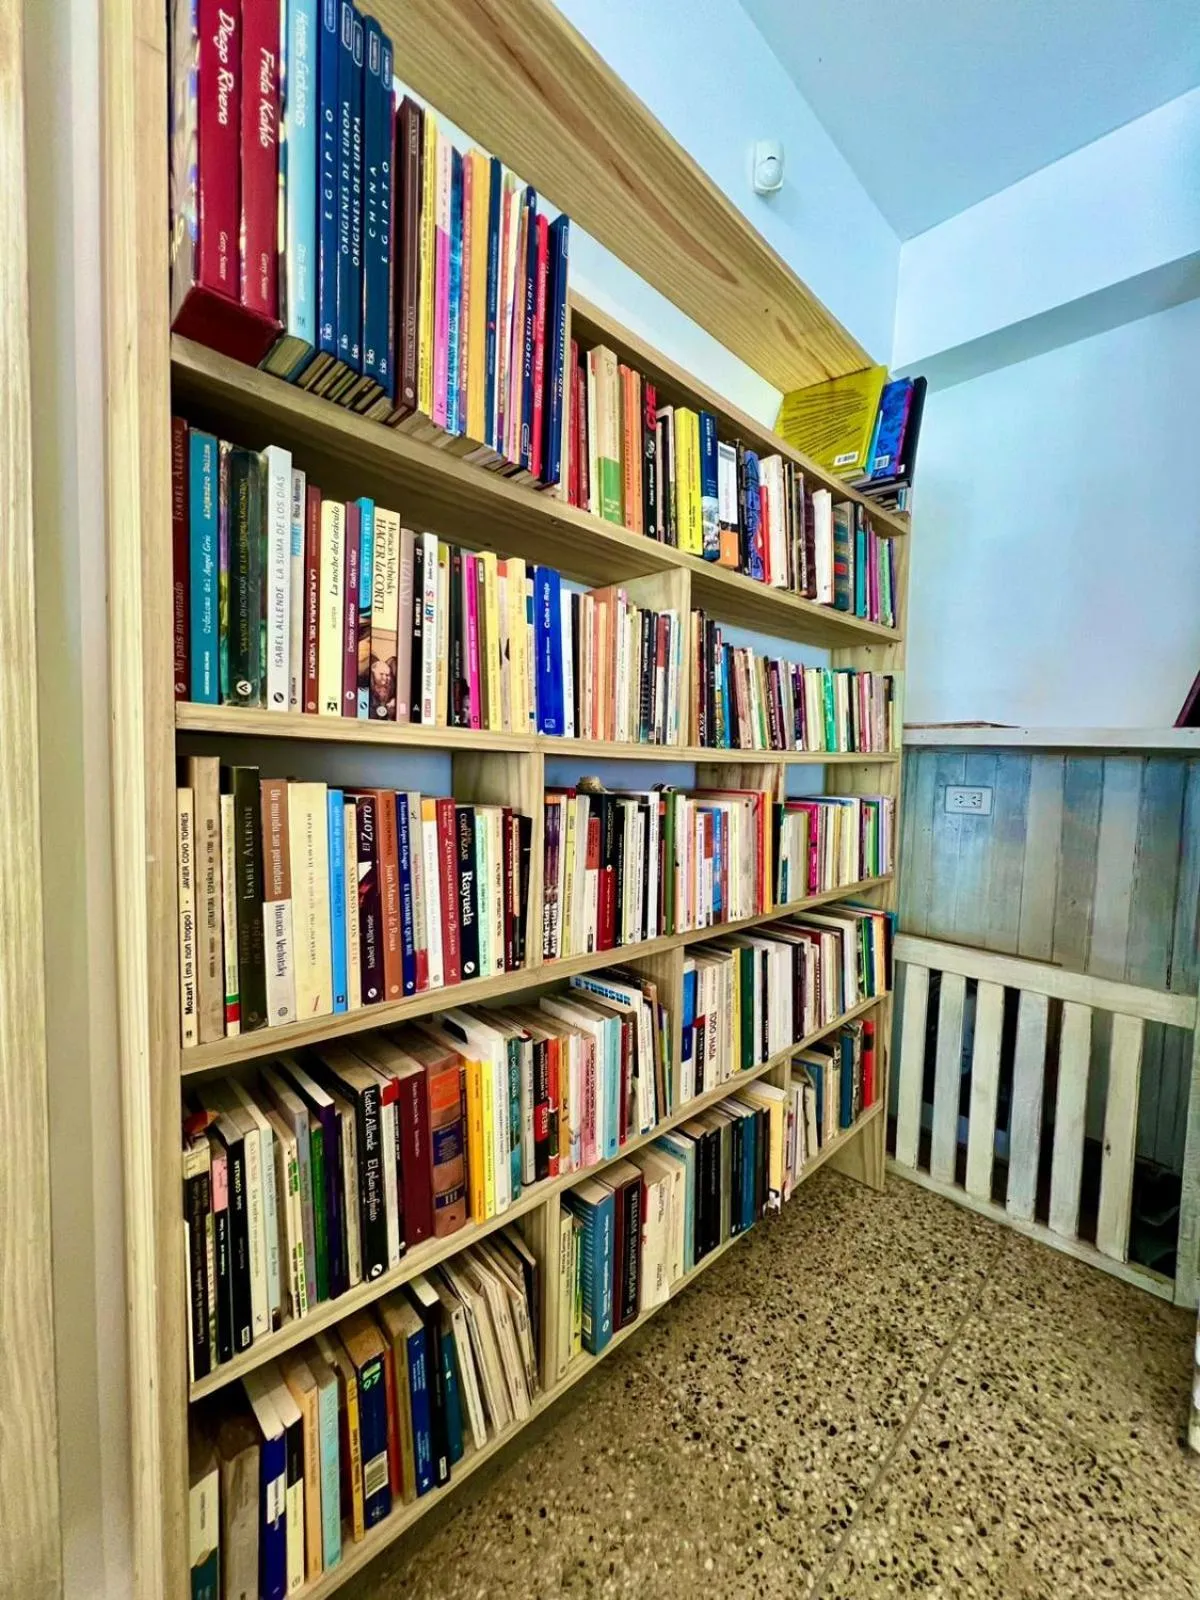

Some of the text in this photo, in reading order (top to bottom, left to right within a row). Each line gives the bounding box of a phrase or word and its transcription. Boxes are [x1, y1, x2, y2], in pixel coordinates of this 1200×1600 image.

[212, 8, 236, 126] Diego Rivera
[258, 47, 275, 149] Frida Kahlo
[341, 101, 350, 156] EUROPA
[352, 117, 361, 170] EUROPA
[325, 109, 334, 220] EGIPTO
[342, 162, 350, 178] DE
[353, 176, 361, 192] DE
[368, 165, 377, 238] CHINA
[380, 161, 390, 263] EGIPTO
[525, 277, 534, 312] INDIA
[174, 429, 184, 521] ISABEL ALLENDE
[202, 476, 212, 520] Alejandro
[329, 506, 340, 596] La noche del oráculo
[387, 521, 397, 556] Horacio
[203, 578, 212, 593] del
[275, 475, 285, 668] ISABEL ALLENDE LA SUMA DE LOS DÍAS
[373, 518, 386, 613] HACER la CORTE
[174, 582, 185, 673] Mi país inventado
[308, 569, 317, 679] LA PLEGARIA DEL VIDENTE
[348, 603, 356, 628] rabioso
[348, 628, 356, 653] Destino
[543, 607, 552, 629] Cuba
[180, 812, 190, 889] JAVIER COVO TORRES
[242, 806, 255, 899] ISABEL ALLENDE
[271, 789, 283, 895] Un mundo sin periodistas
[361, 804, 373, 851] El Zorro
[385, 864, 395, 887] Juan
[386, 888, 396, 916] Manuel
[461, 871, 474, 926] Rayuela
[275, 903, 286, 977] Horacio Verbitsky
[366, 915, 376, 968] Isabel Allende
[388, 917, 396, 927] de
[404, 927, 412, 942] QUE
[181, 910, 193, 1015] Mozart (ma non troppo)
[708, 1011, 718, 1033] TODO
[365, 1089, 379, 1151] Isabel Allende
[540, 1107, 548, 1134] FREUD
[367, 1170, 378, 1190] plan
[368, 1158, 378, 1170] El
